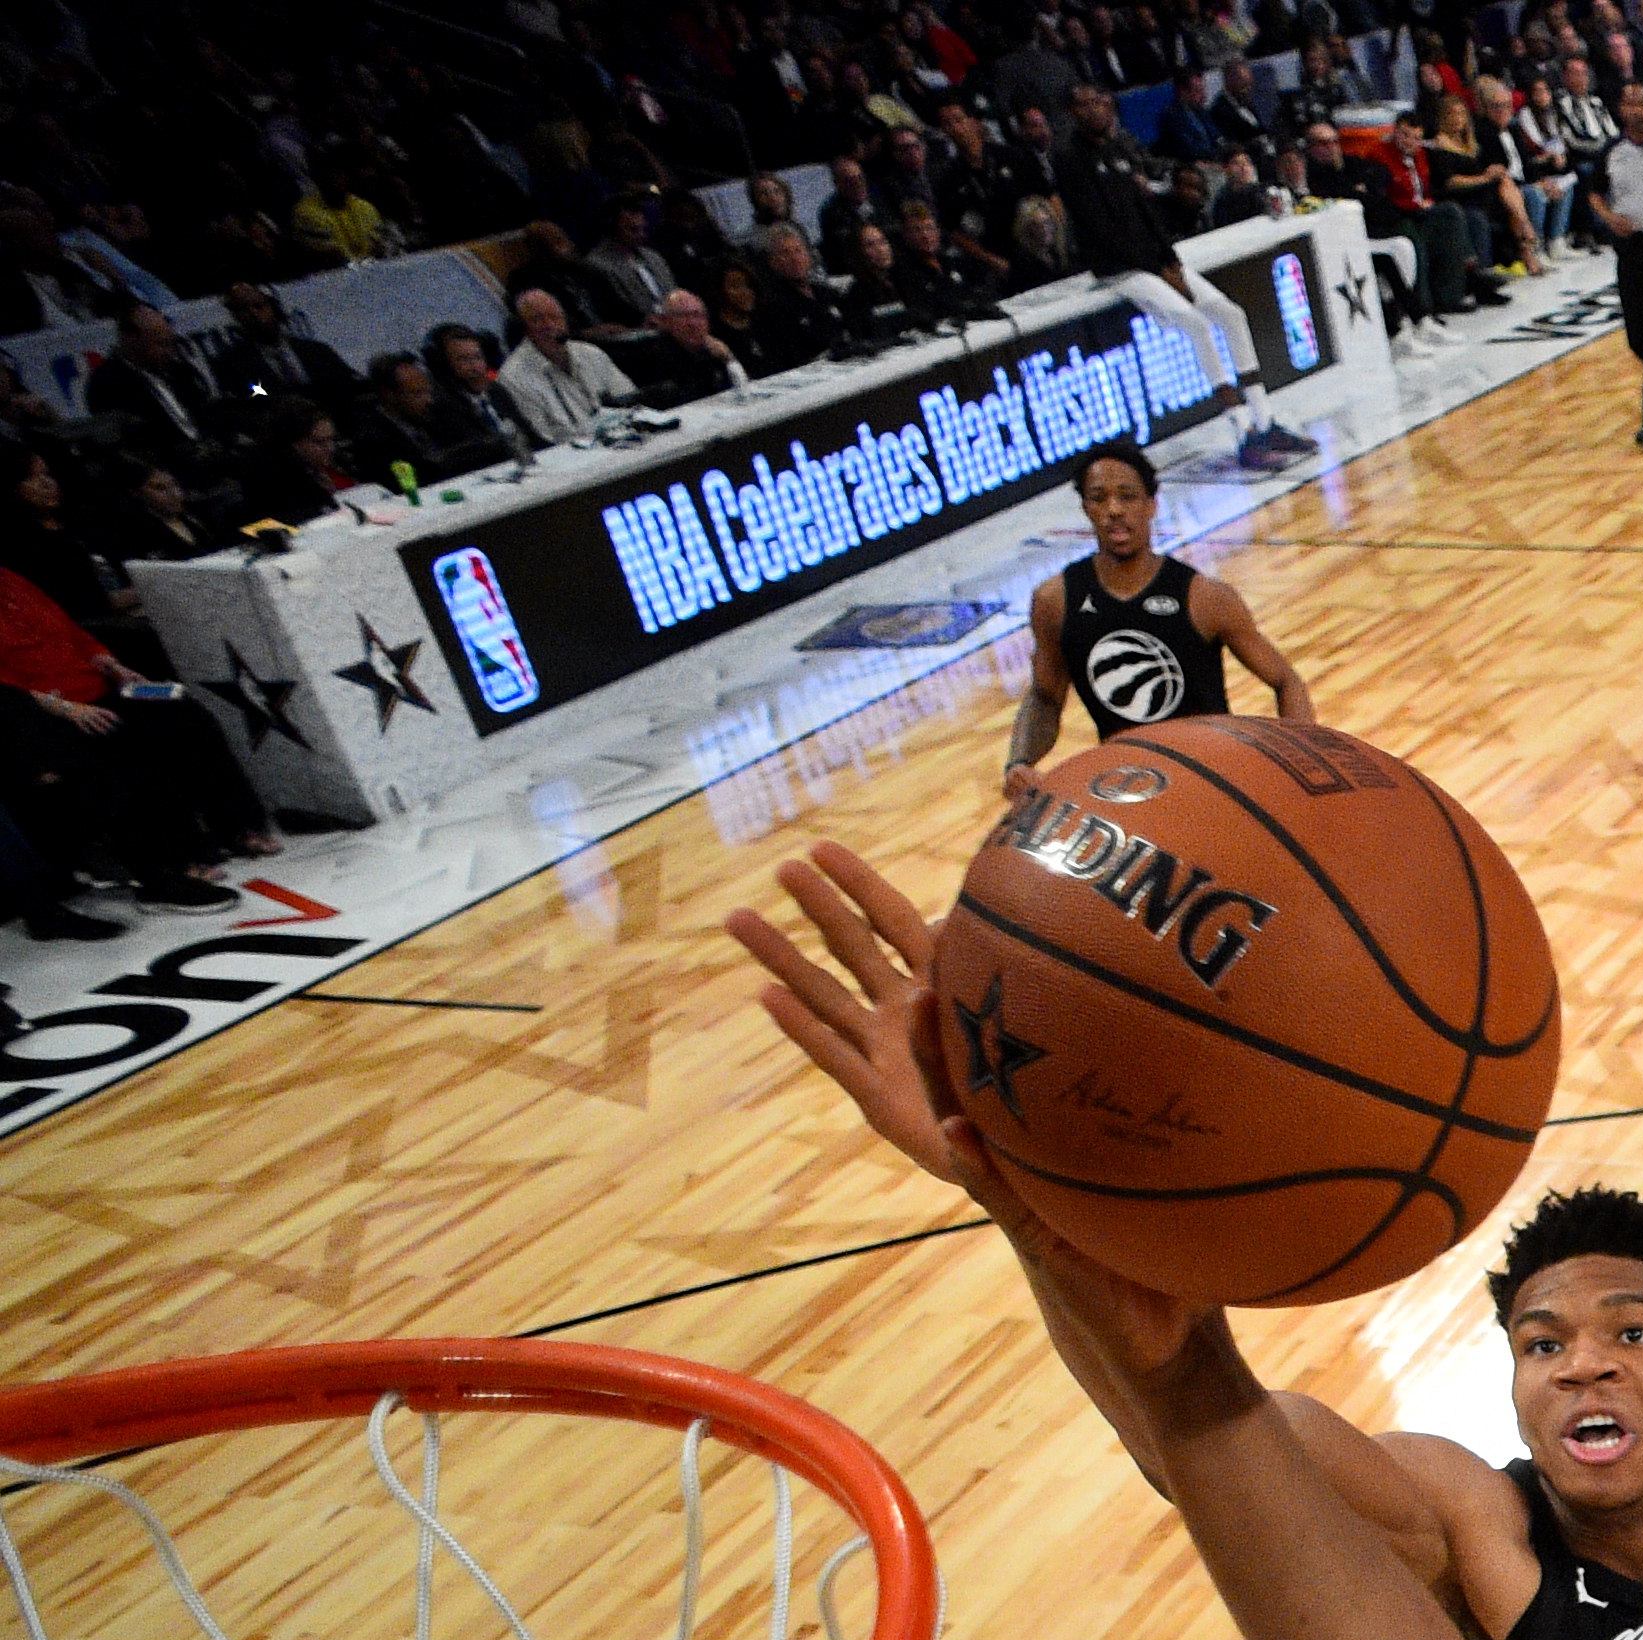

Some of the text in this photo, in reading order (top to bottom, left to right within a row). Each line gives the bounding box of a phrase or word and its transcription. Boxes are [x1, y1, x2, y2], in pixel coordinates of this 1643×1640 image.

[602, 482, 732, 634] NBA
[701, 421, 944, 593] Celebrates
[919, 365, 1044, 505] Black
[1018, 344, 1151, 446] History
